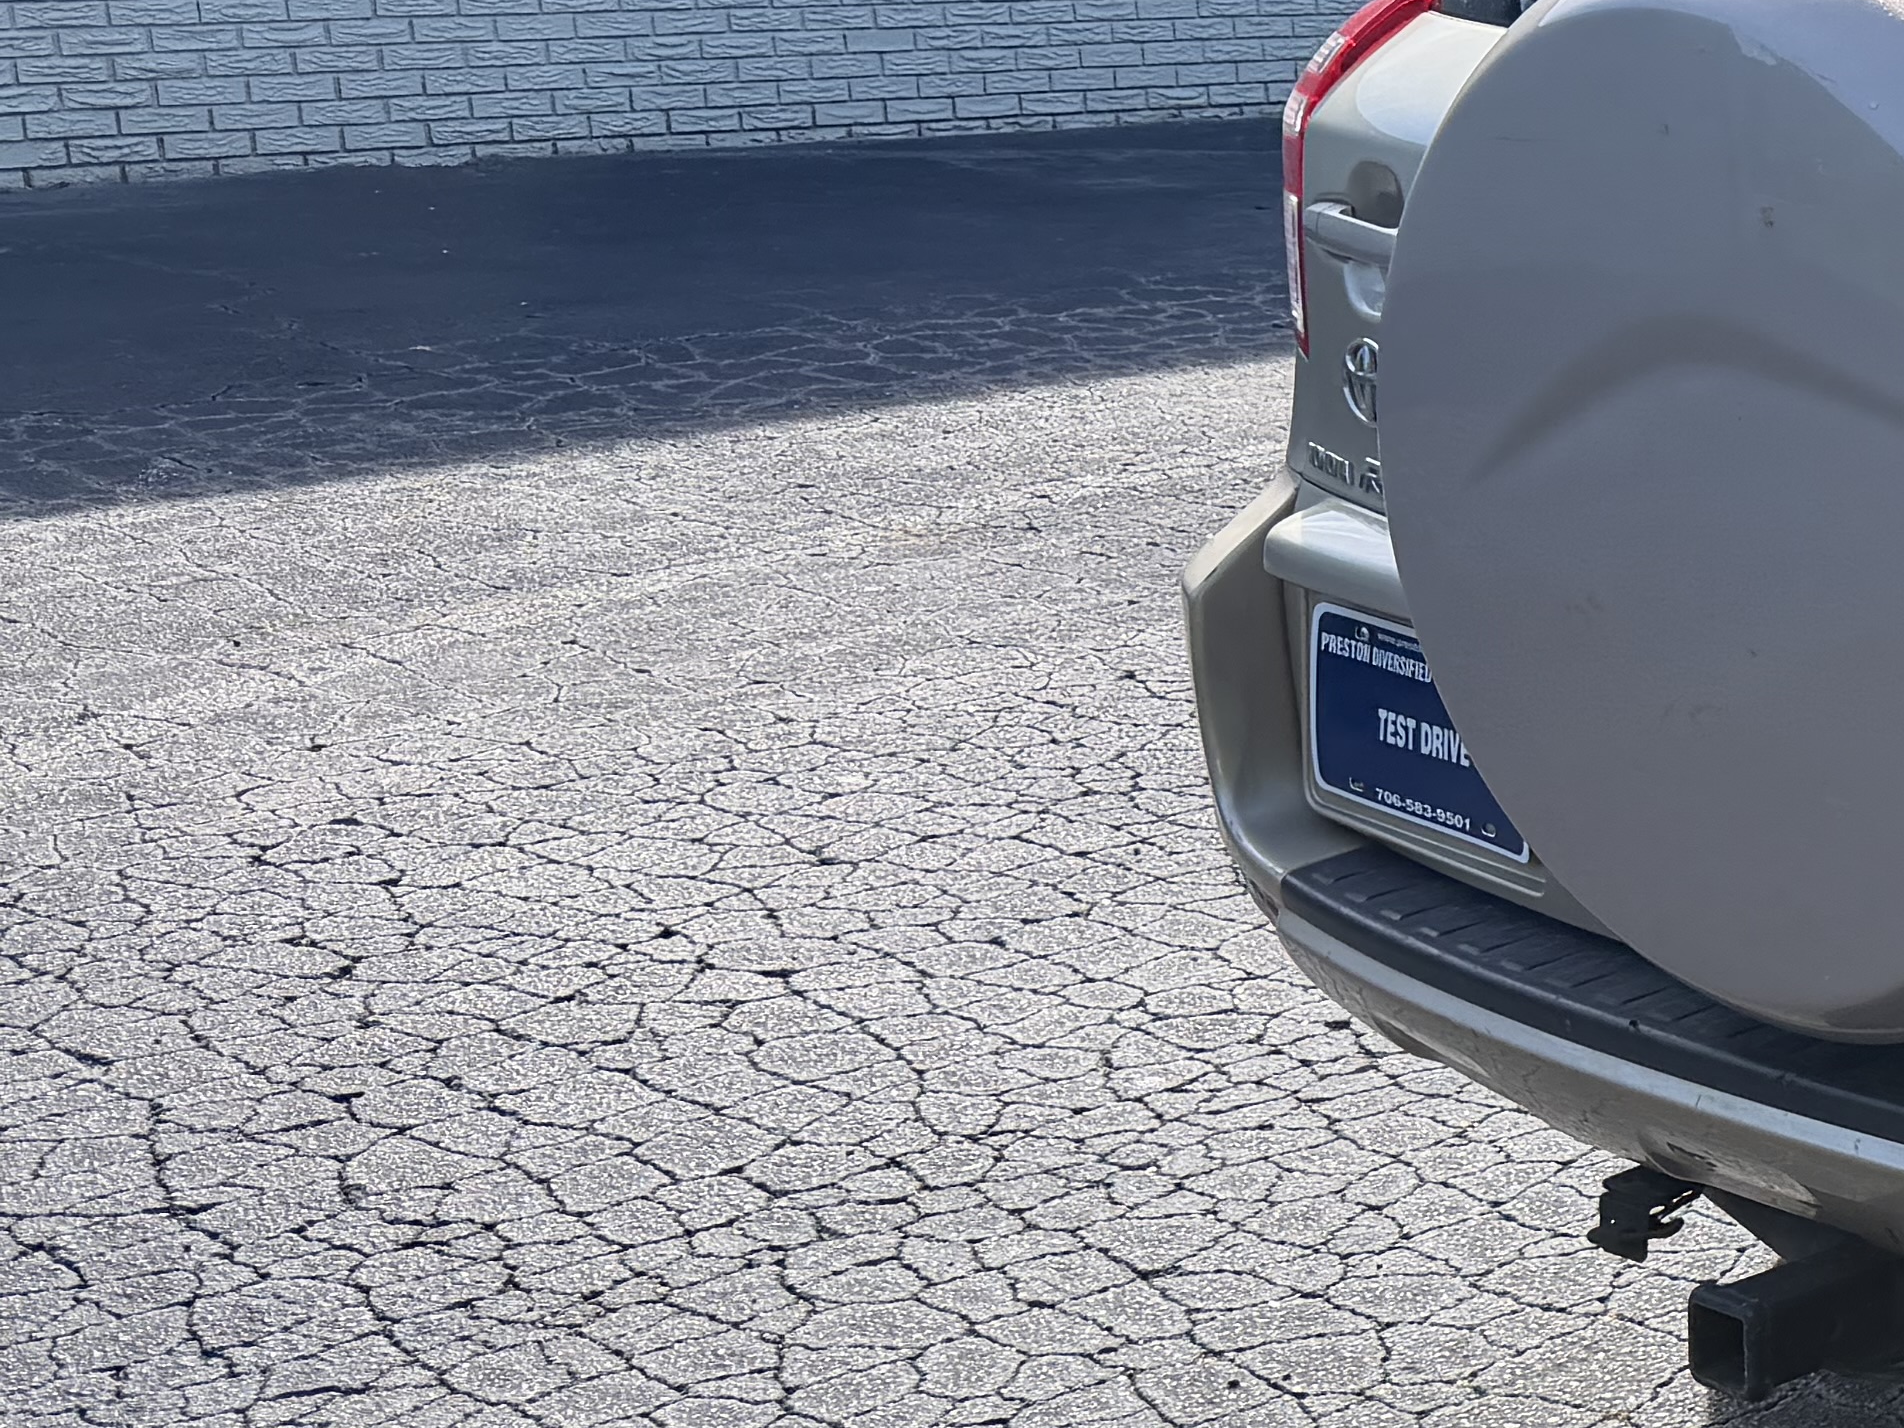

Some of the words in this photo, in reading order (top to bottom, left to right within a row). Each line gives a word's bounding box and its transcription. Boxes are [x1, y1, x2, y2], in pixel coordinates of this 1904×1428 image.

[1320, 631, 1370, 664] PRESTON
[1371, 645, 1433, 683] DIVERSIFIED
[1378, 708, 1417, 751] TEST
[1375, 787, 1471, 832] 706-583-9501
